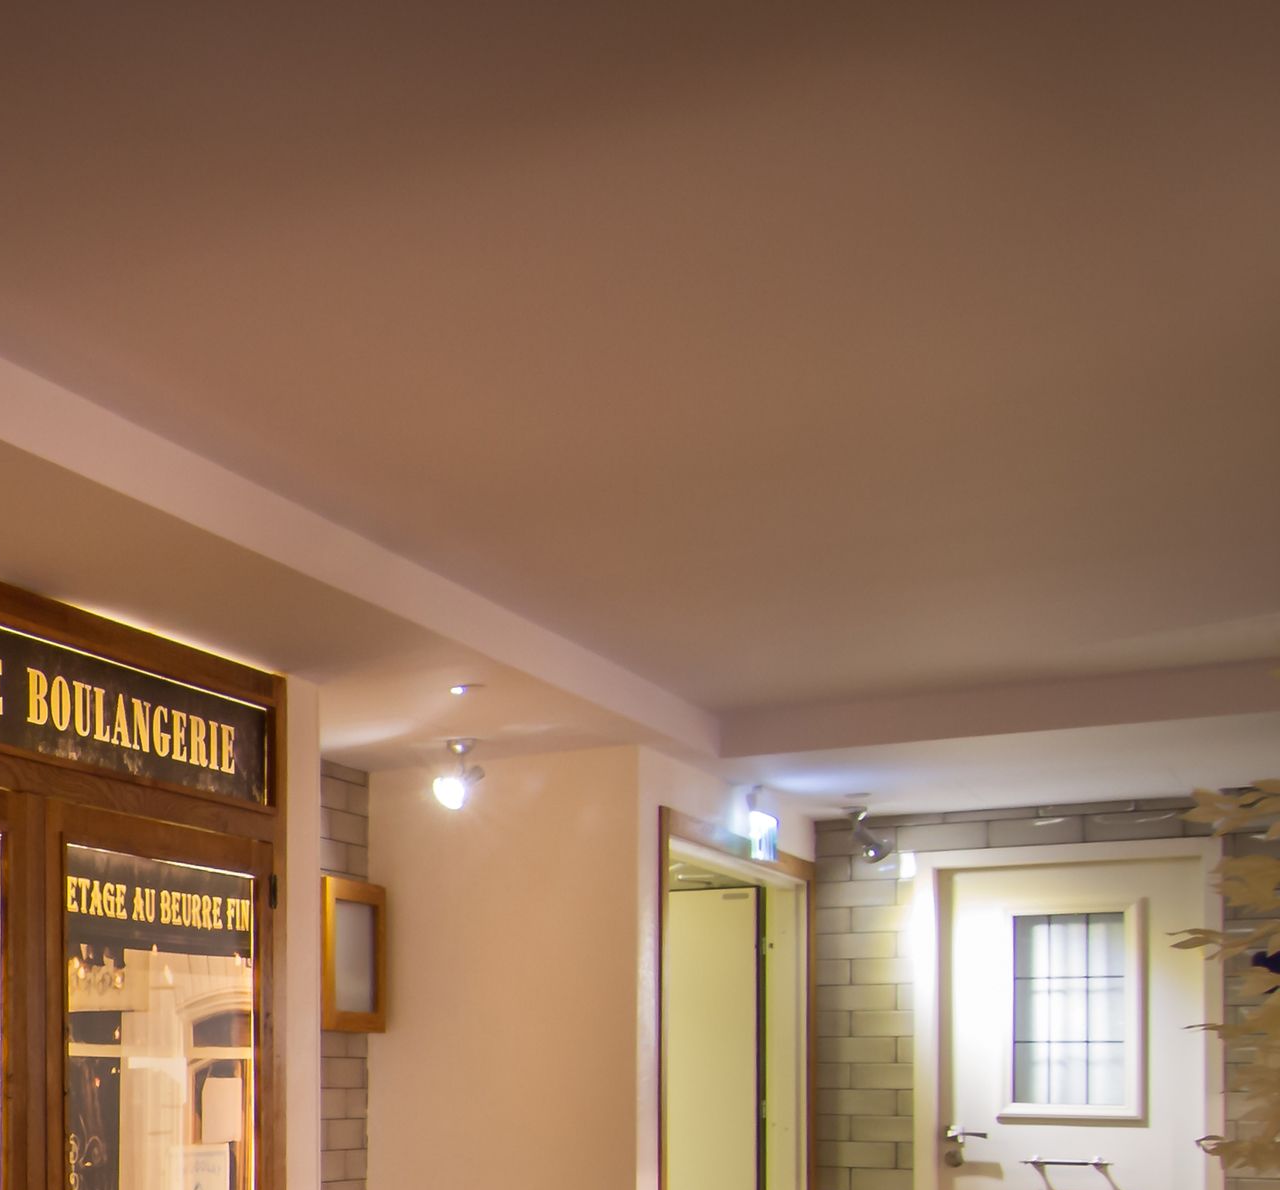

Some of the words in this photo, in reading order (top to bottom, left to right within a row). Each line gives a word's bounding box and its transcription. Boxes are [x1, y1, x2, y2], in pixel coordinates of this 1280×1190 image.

[26, 666, 236, 775] BOULANGERIE
[66, 875, 127, 919] ETAGE
[132, 887, 156, 923] AU
[160, 890, 223, 930] BEURRE
[226, 898, 250, 931] FIN
